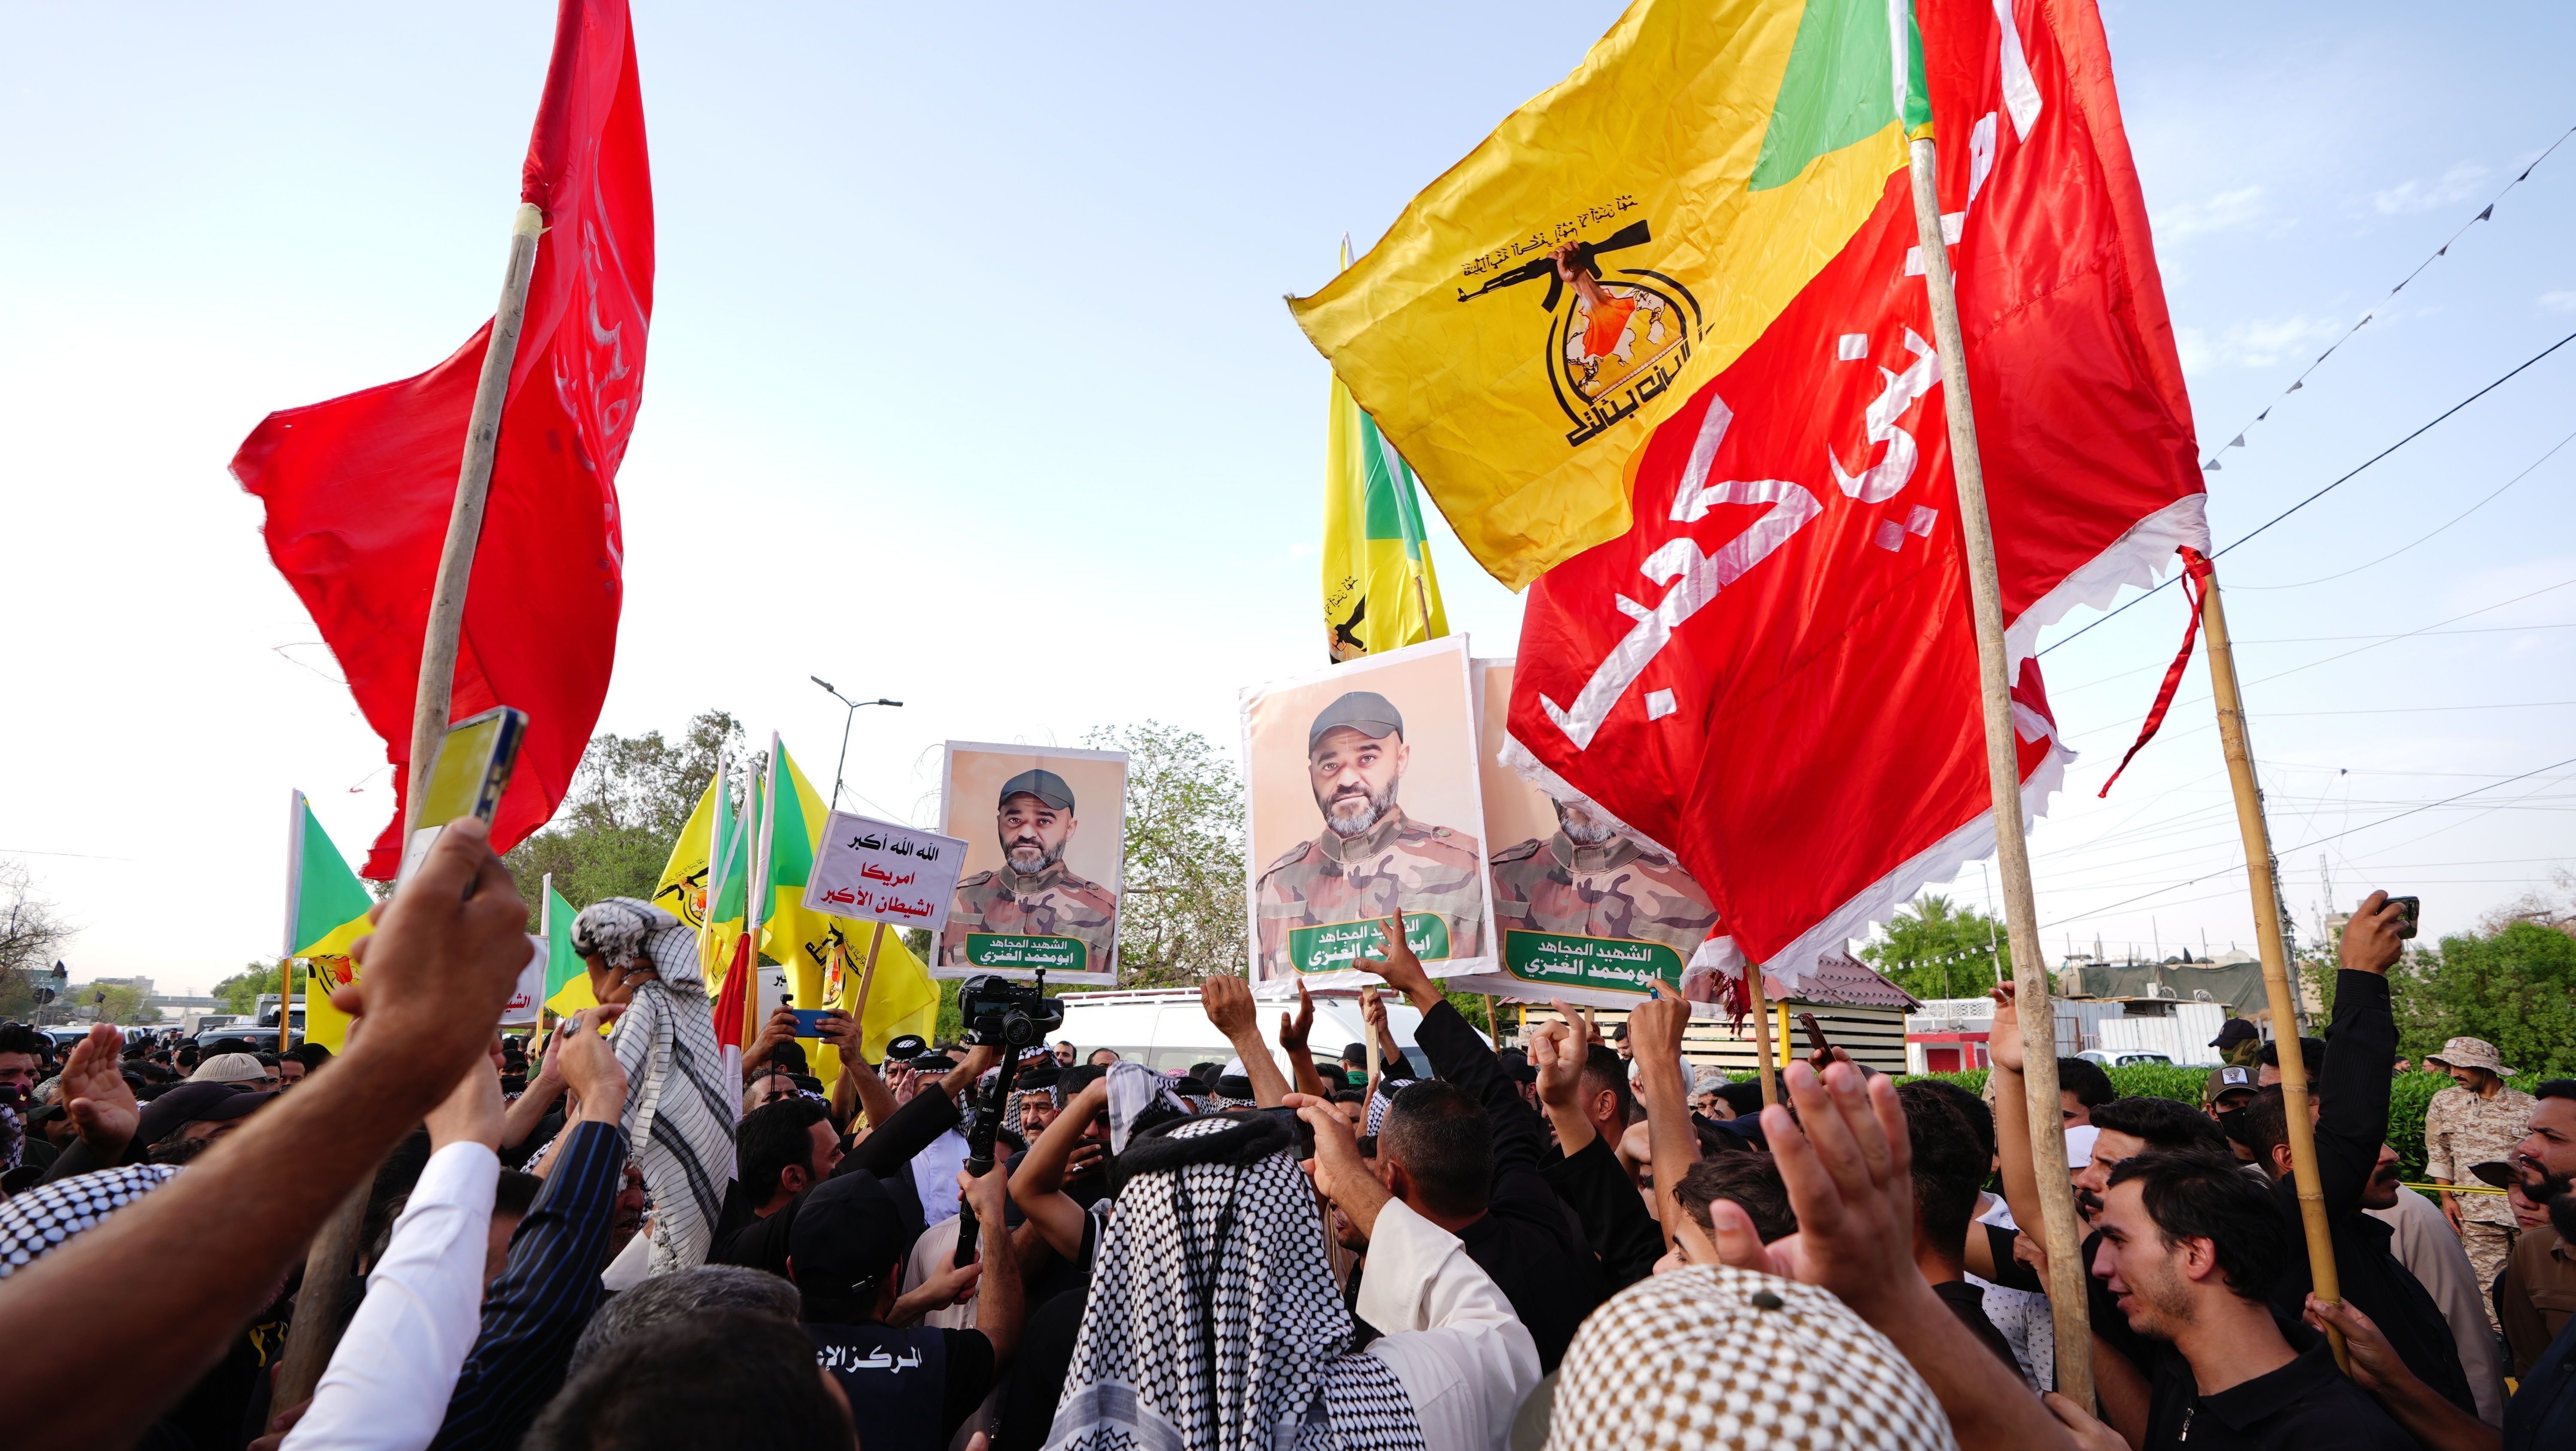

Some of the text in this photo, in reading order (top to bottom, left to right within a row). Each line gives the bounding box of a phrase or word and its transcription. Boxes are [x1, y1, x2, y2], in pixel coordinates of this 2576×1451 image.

[847, 833, 939, 862] الله الله أكبر
[860, 862, 915, 887] امريكا
[820, 885, 935, 919] الشيطان الأكبر
[990, 938, 1068, 951] الشهيد المجاهد
[1318, 925, 1367, 944] المجاهد
[1538, 940, 1652, 962] الشهيد المجاهد
[504, 993, 531, 1014] الشي
[817, 1344, 923, 1374] المركز الإع
